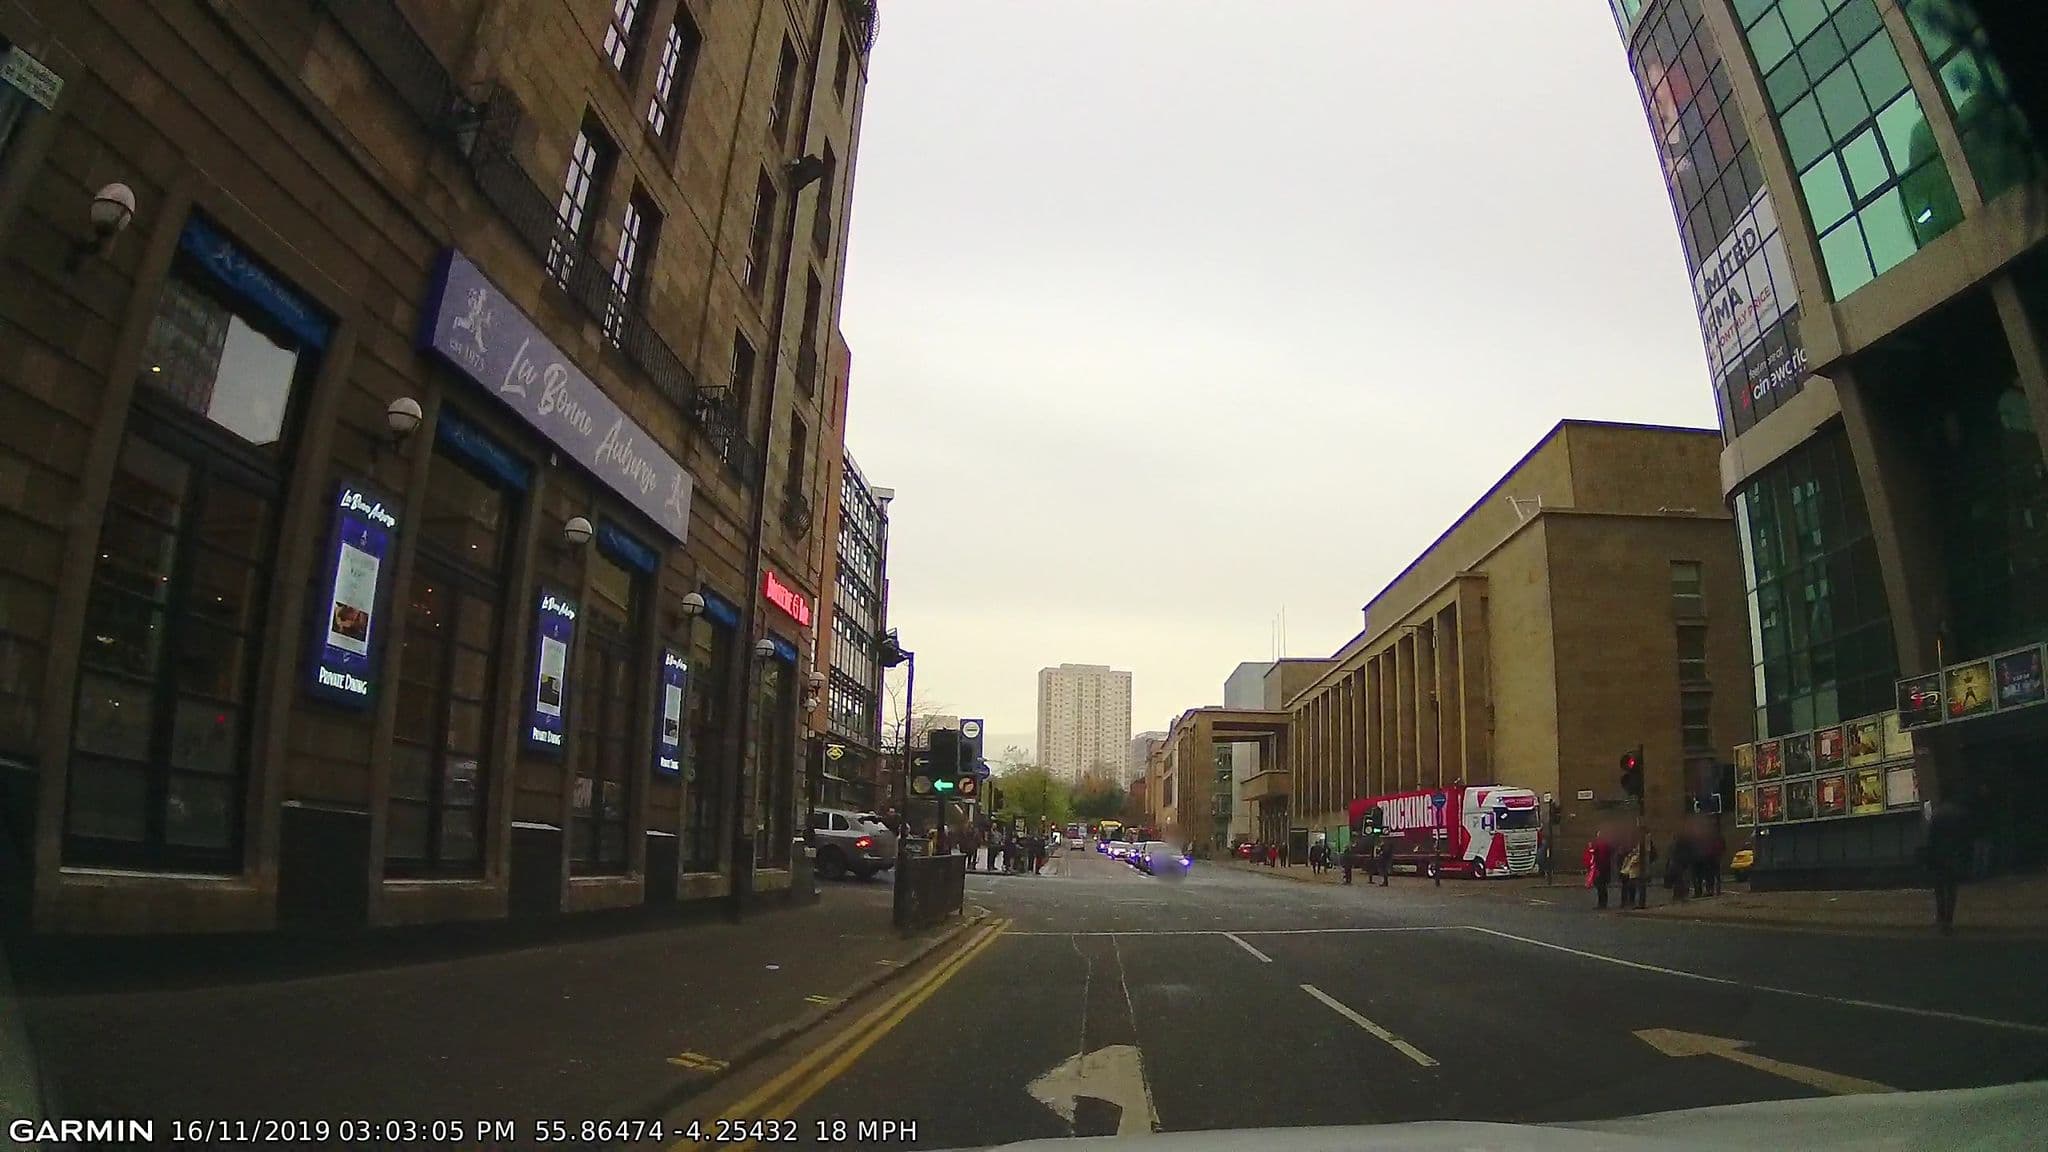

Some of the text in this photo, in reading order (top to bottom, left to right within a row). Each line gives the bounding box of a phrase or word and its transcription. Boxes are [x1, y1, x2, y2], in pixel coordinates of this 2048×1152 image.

[500, 336, 537, 398] La
[536, 362, 593, 437] Bonne
[594, 416, 657, 495] Auberge
[1377, 793, 1432, 831] TRUCKING
